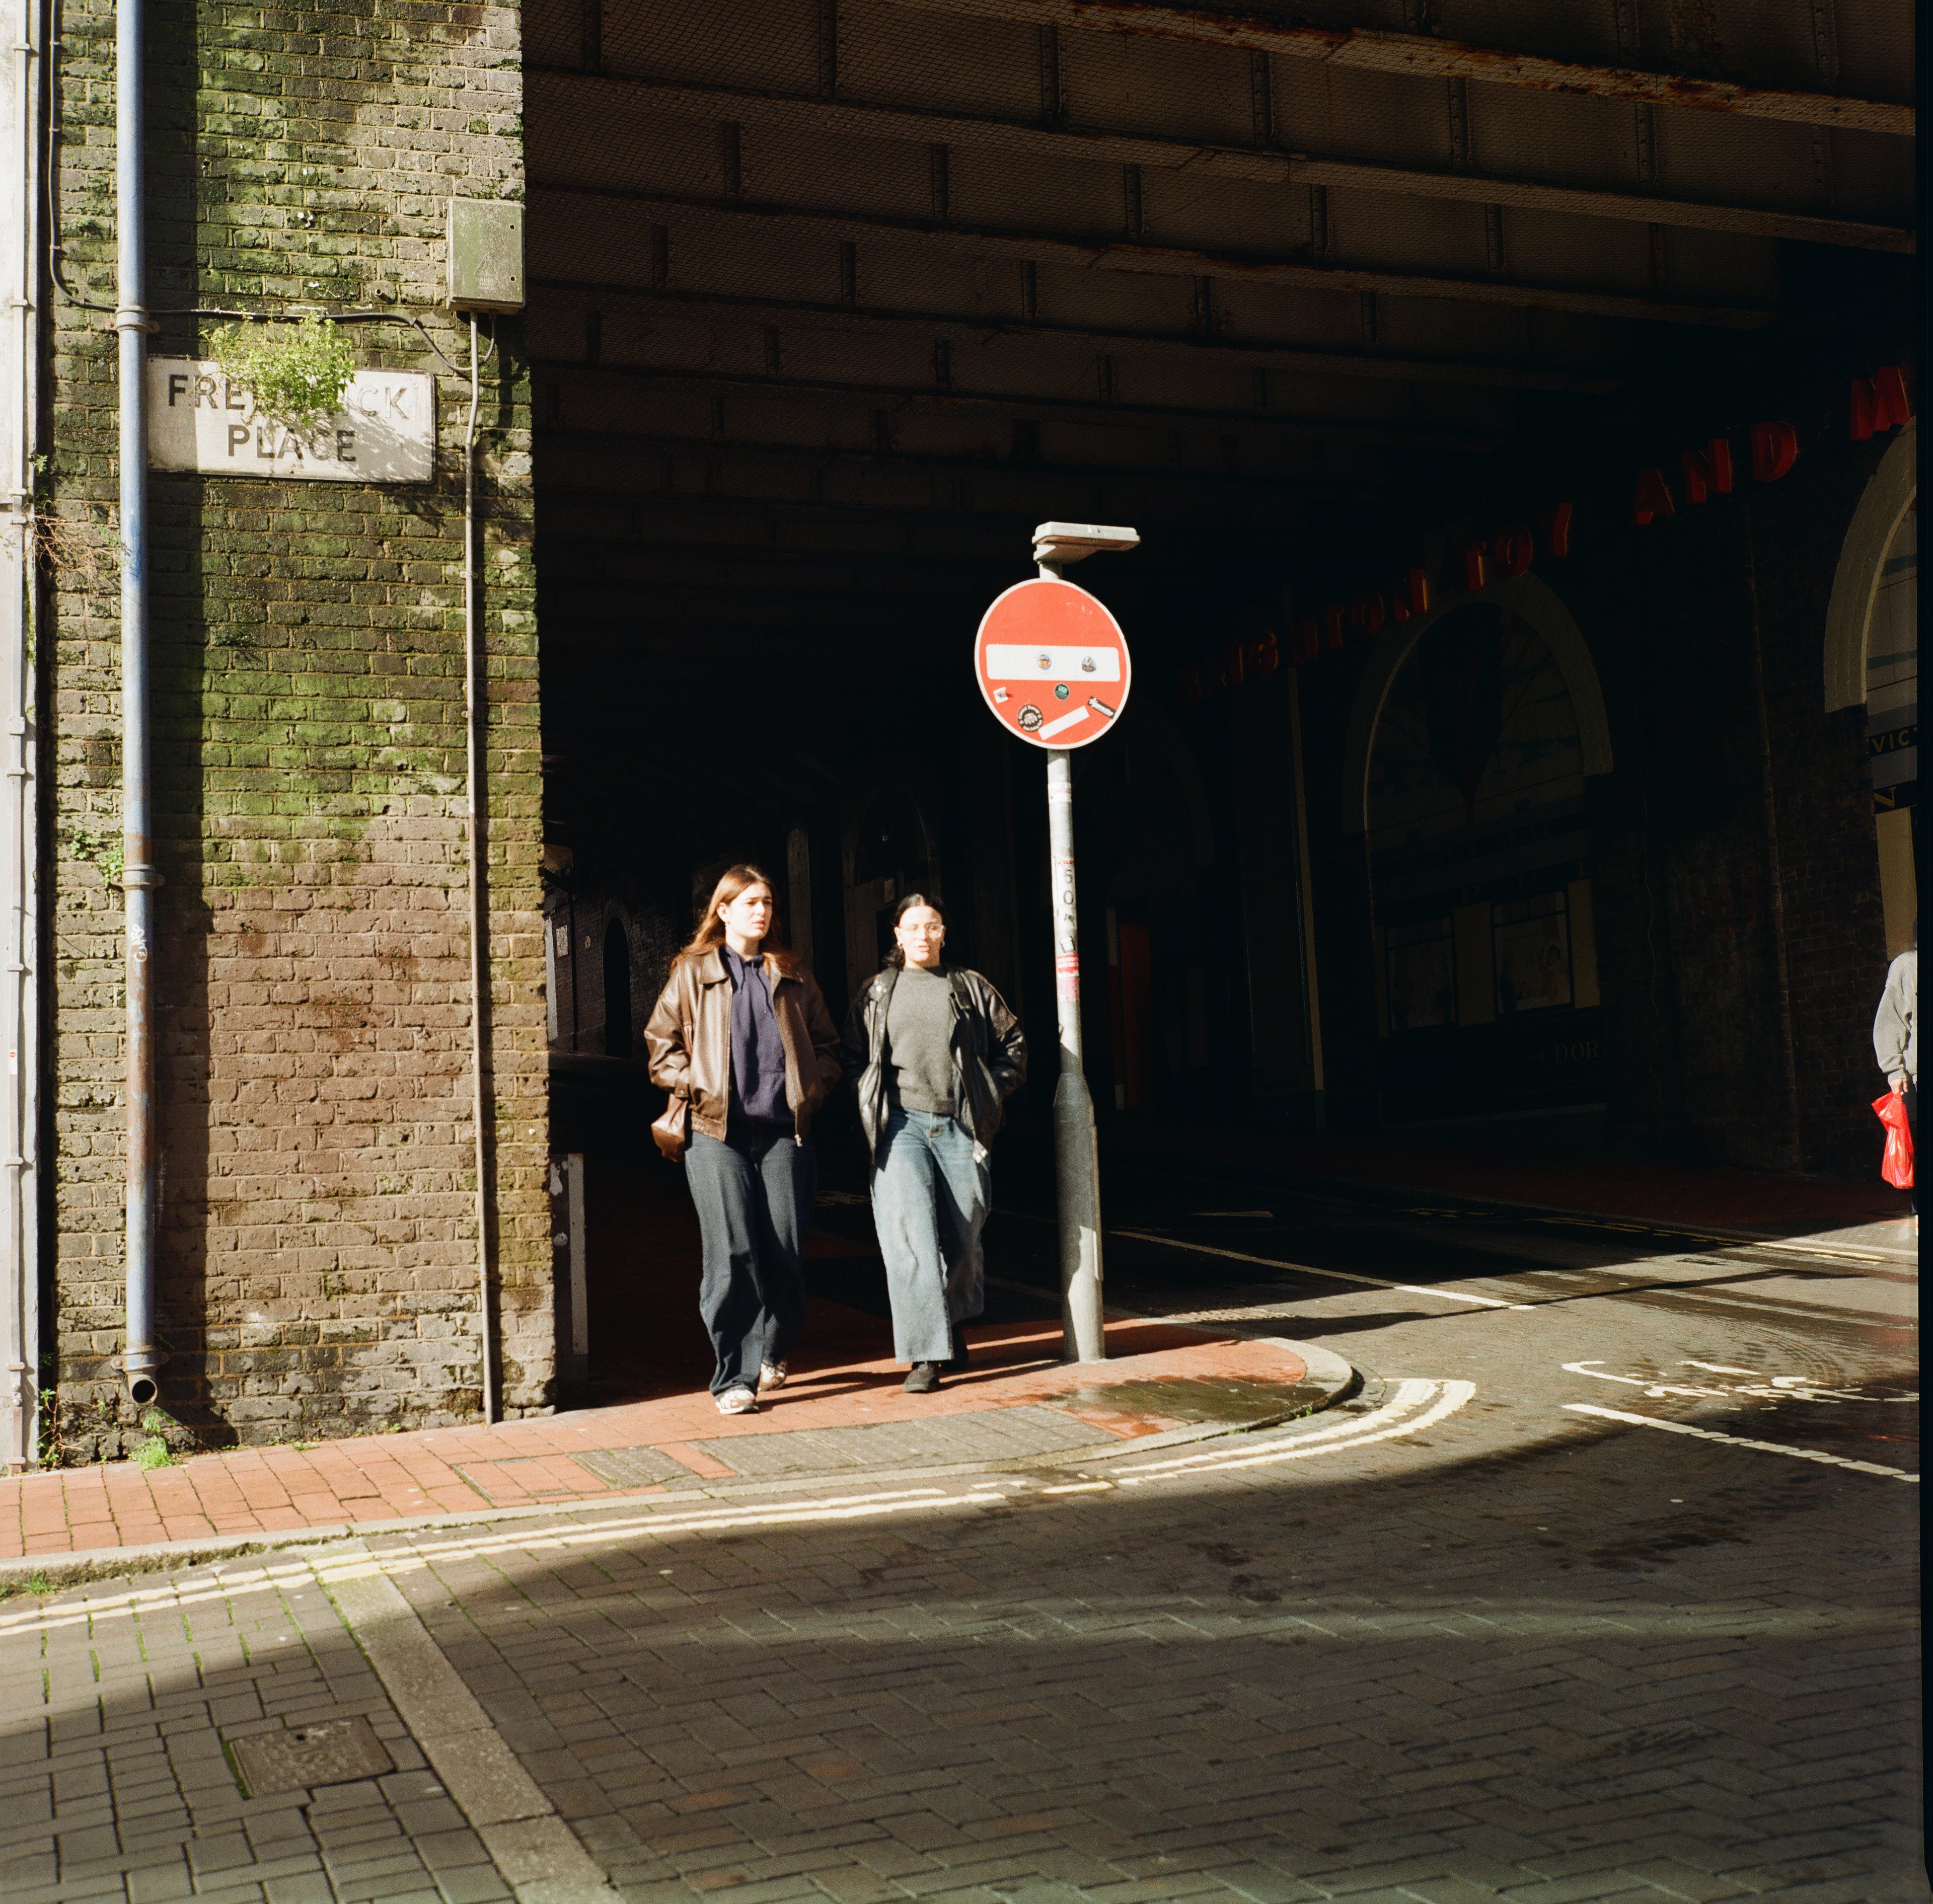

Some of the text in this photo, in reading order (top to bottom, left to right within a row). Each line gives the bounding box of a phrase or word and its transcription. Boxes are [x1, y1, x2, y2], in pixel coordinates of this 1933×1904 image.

[168, 373, 409, 420] FREICK
[228, 424, 356, 463] PLACE
[1176, 567, 1429, 706] BRIGHTON
[1459, 502, 1574, 591] TOY
[1630, 420, 1799, 526] AND
[1871, 727, 1917, 753] VIC
[1554, 1040, 1599, 1063] DOR
